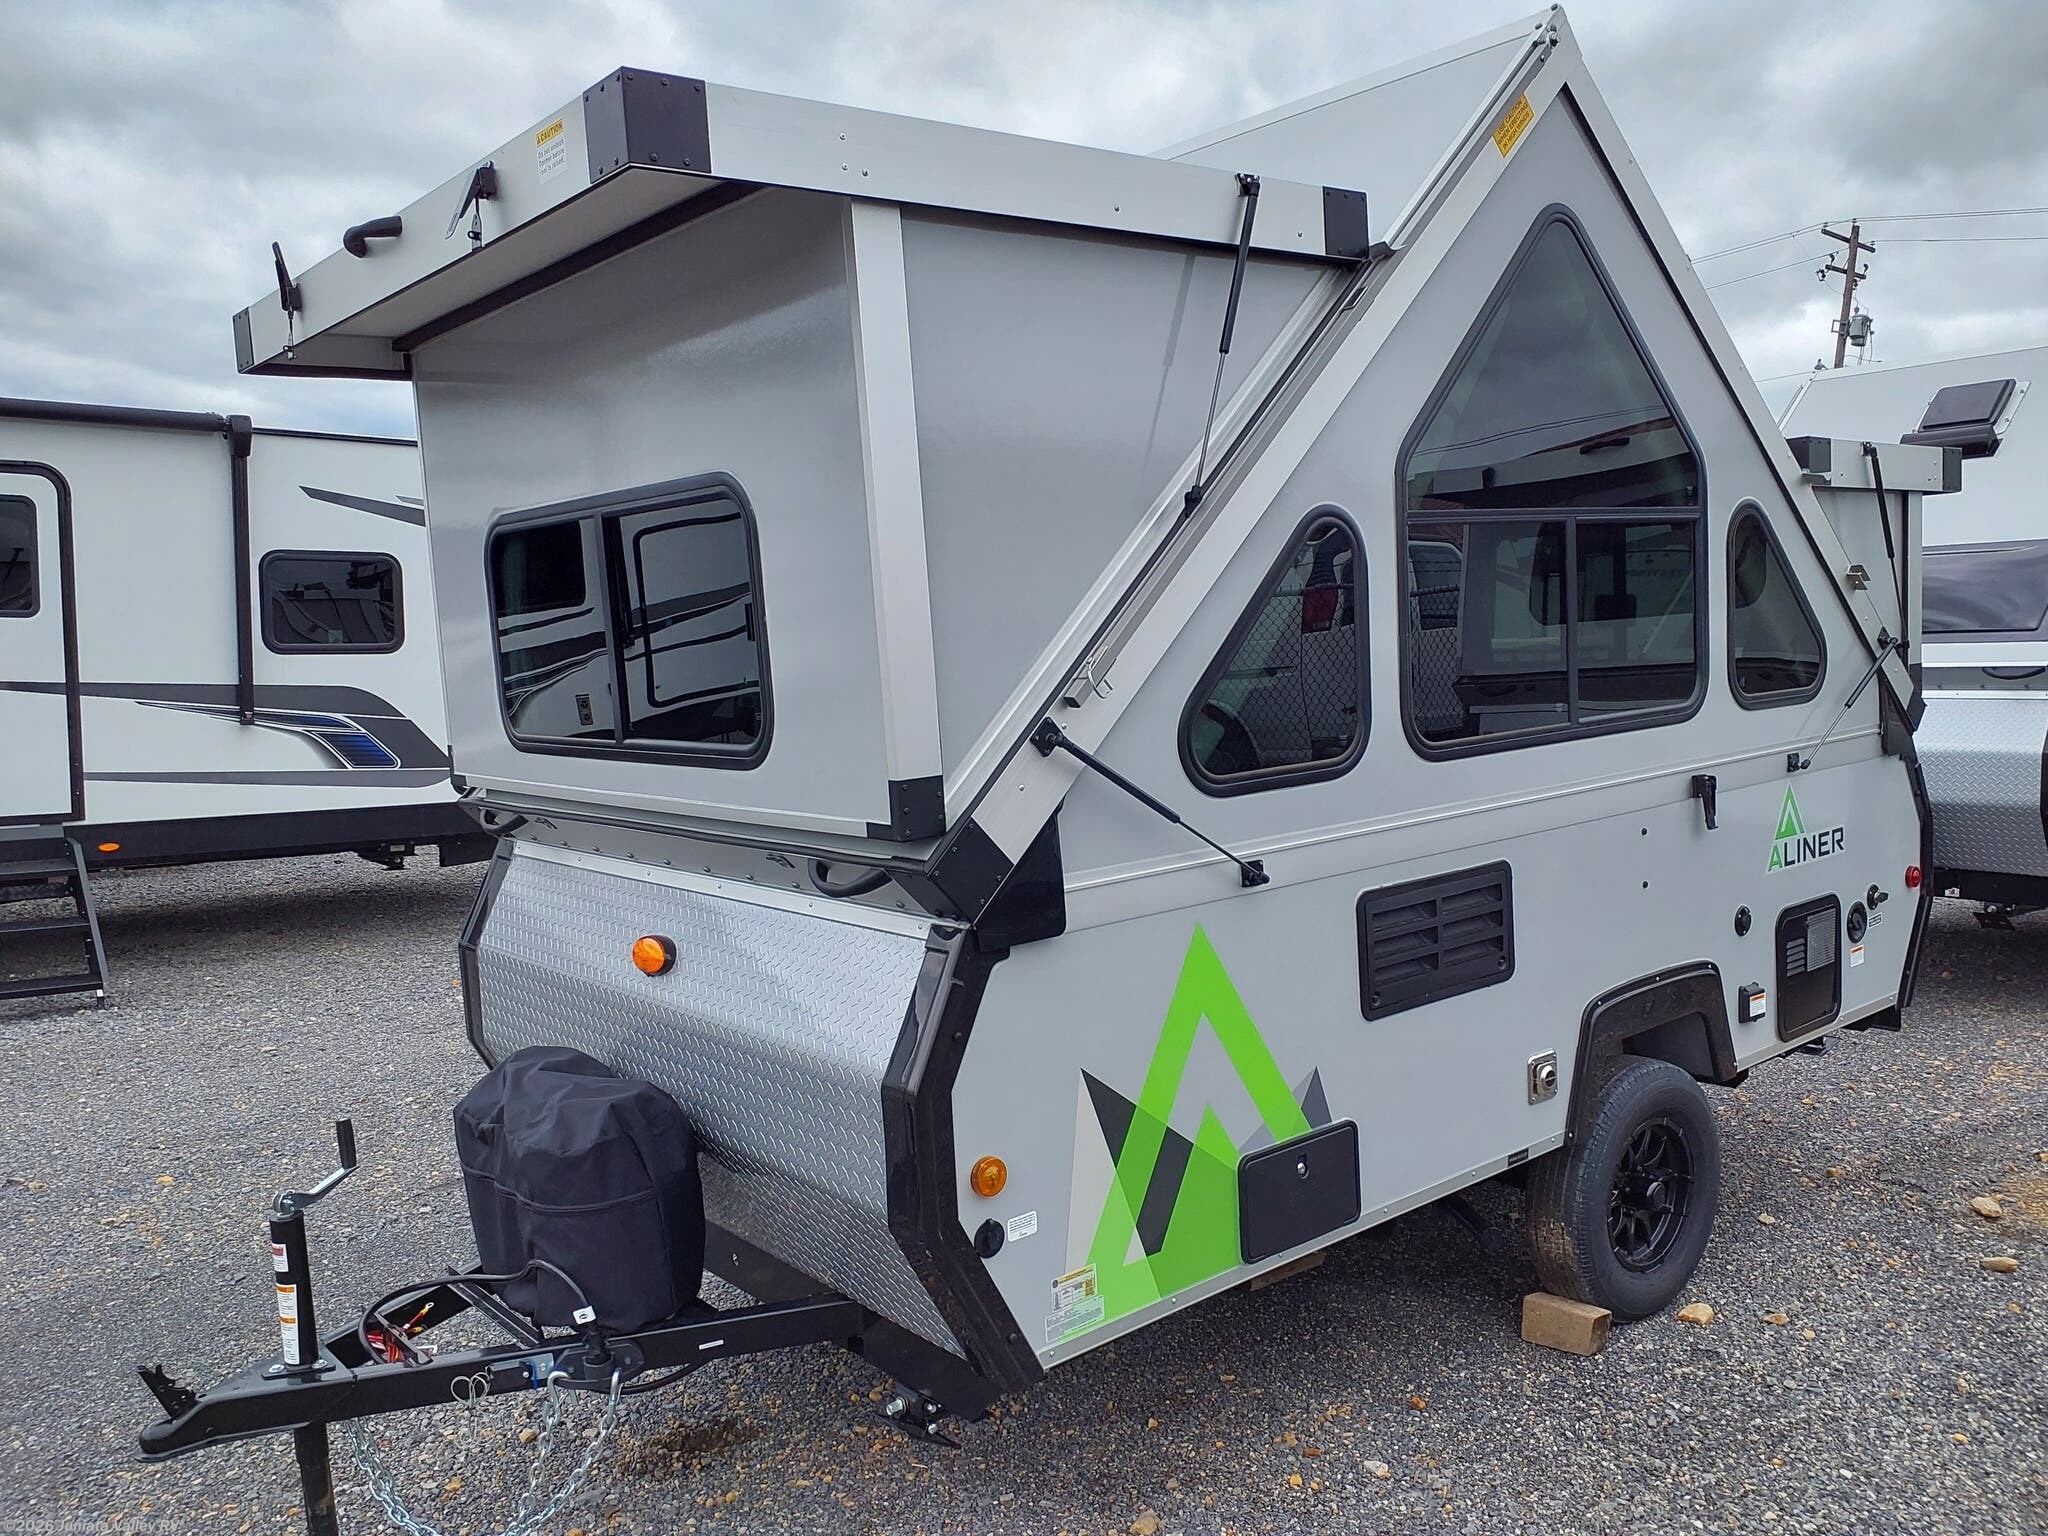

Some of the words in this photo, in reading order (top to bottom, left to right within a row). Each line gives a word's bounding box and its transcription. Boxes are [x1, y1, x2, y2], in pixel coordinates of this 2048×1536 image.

[1504, 98, 1523, 124] CAUTION
[1507, 101, 1529, 130] ERECTING
[540, 120, 563, 142] CAUTION
[1767, 826, 1845, 872] ALINER
